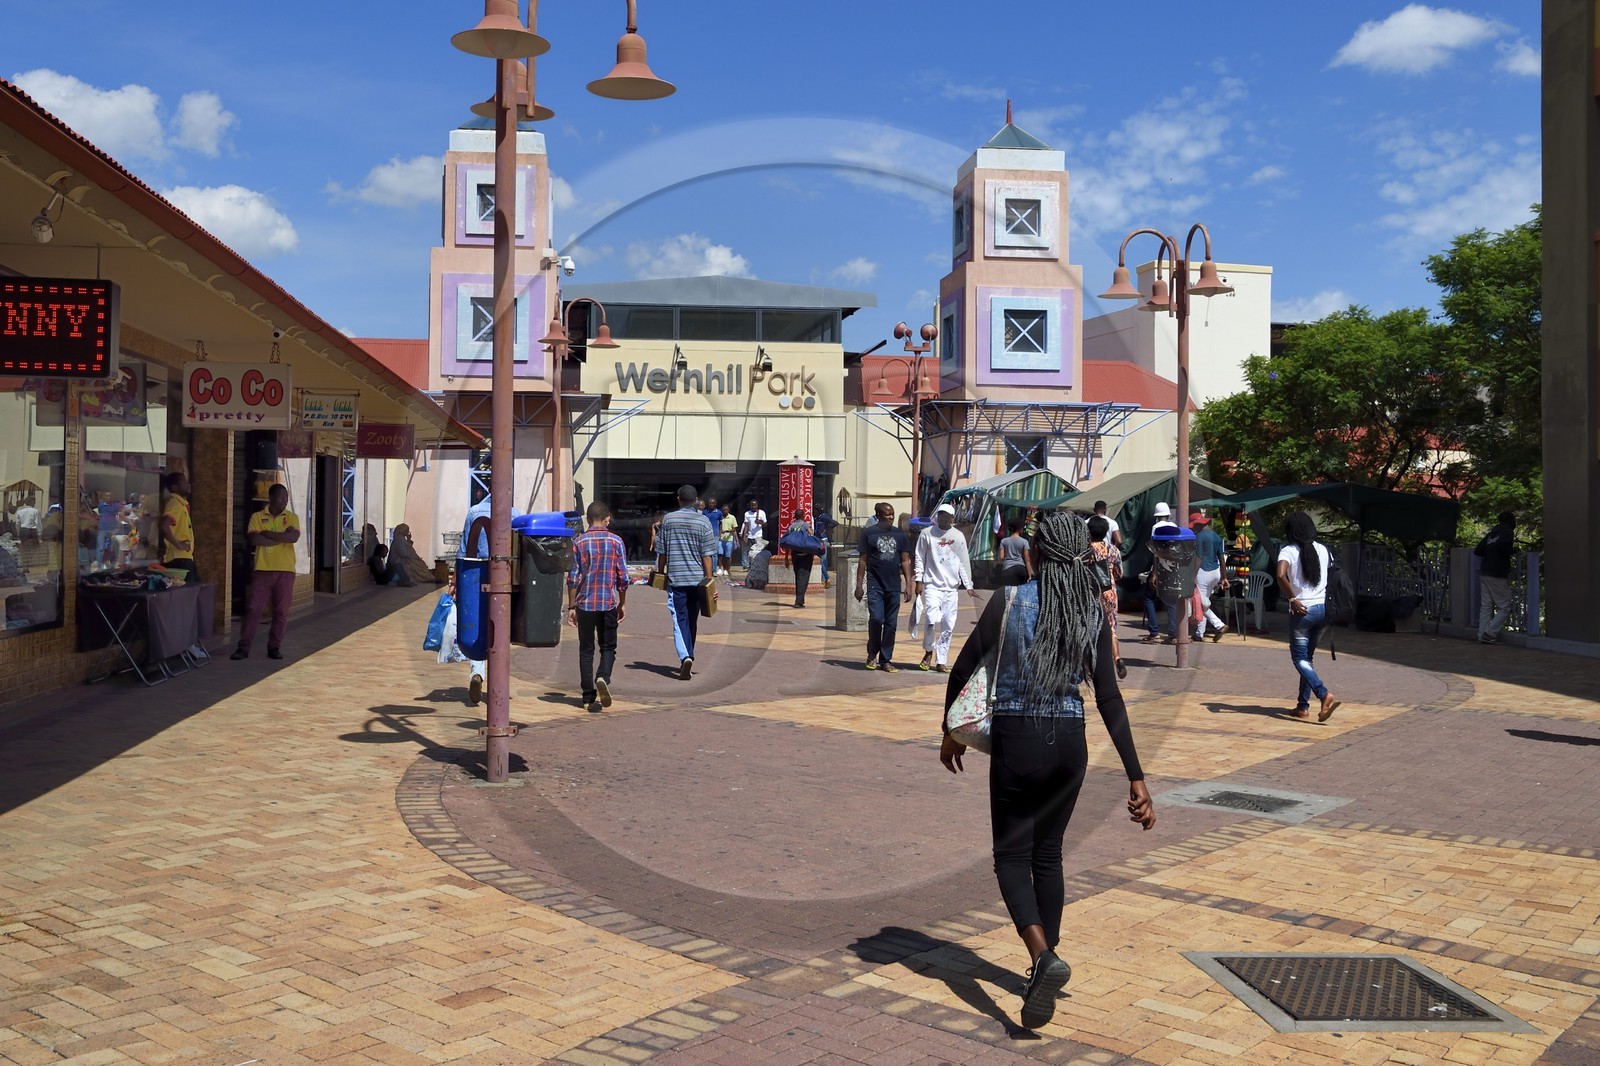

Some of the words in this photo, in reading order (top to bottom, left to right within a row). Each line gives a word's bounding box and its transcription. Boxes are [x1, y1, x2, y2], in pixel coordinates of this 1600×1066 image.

[0, 302, 90, 337] NNY
[189, 367, 232, 405] Co
[241, 369, 284, 406] Co
[614, 361, 743, 395] Wernhil
[750, 364, 816, 396] Park
[199, 411, 265, 423] pretty
[364, 431, 407, 450] Zooty
[781, 467, 790, 519] EXCLUSIVE
